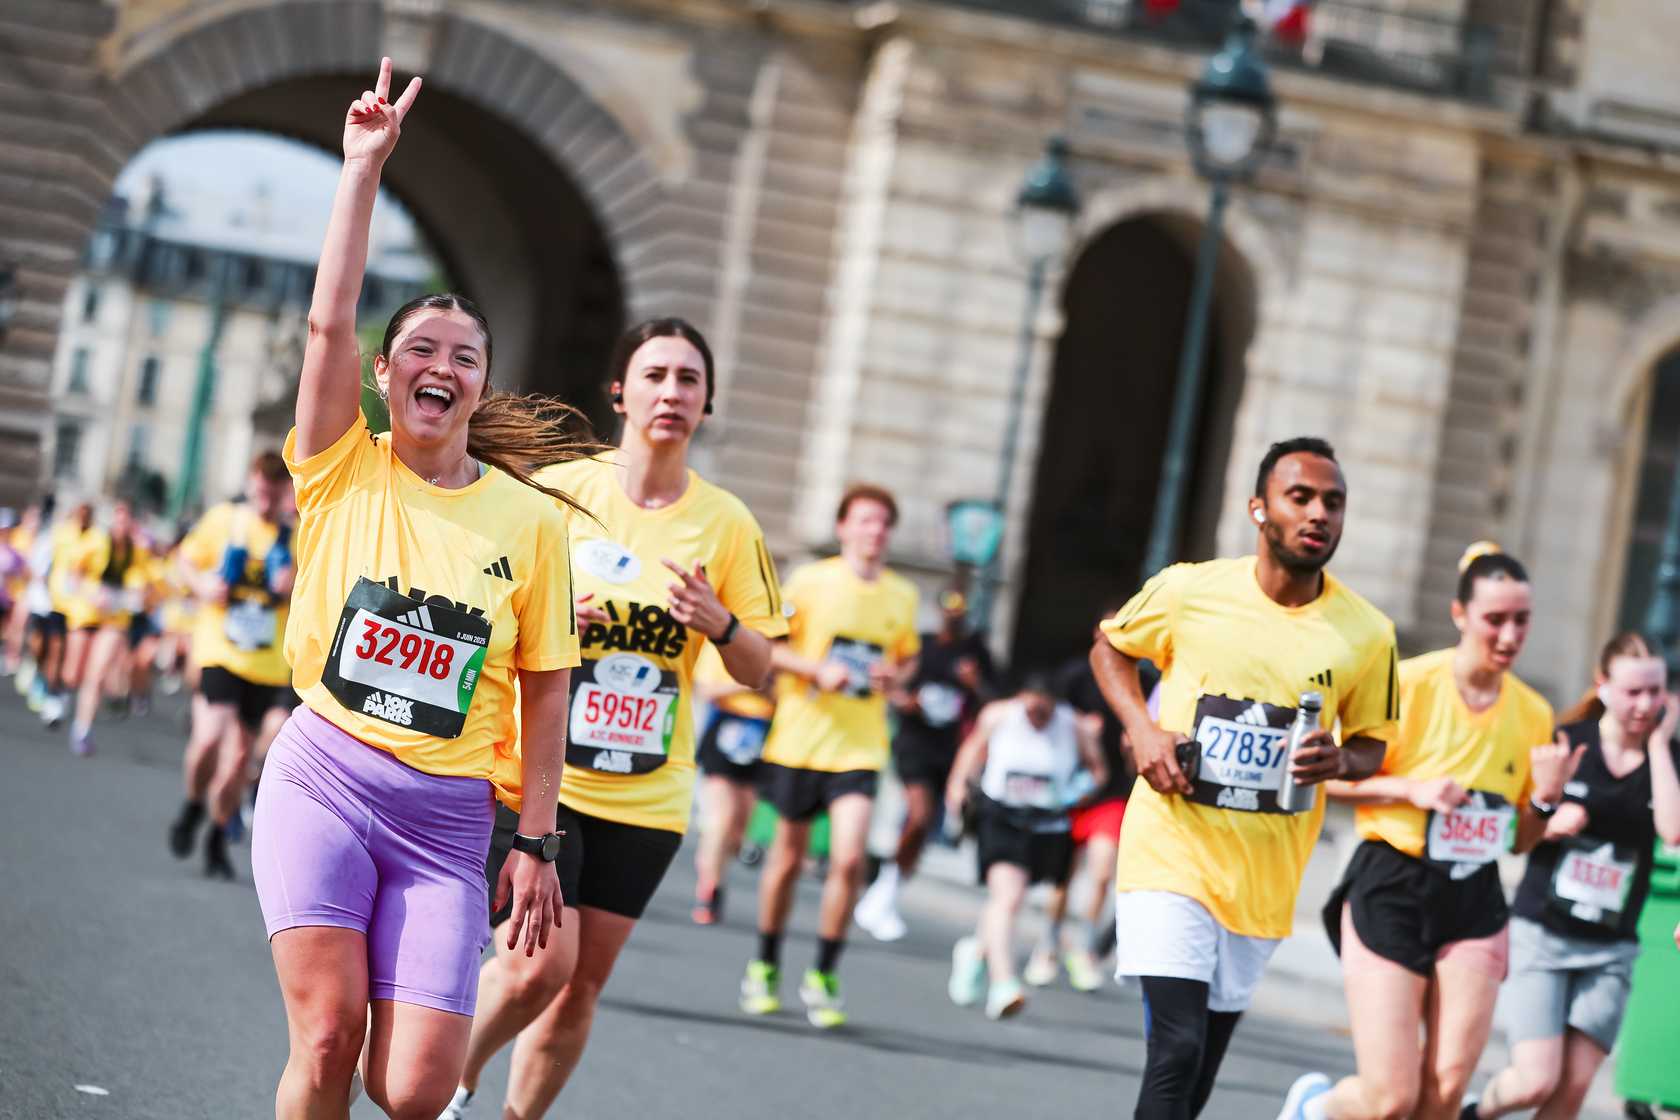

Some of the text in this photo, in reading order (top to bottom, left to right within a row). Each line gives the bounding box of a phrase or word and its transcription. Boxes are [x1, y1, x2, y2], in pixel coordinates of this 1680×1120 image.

[355, 619, 455, 681] 32918
[456, 631, 486, 645] 8 JUIN 2025
[581, 622, 686, 659] PARIS
[462, 668, 477, 691] 54 MIN
[362, 698, 413, 726] PARIS
[384, 693, 415, 719] 10K
[584, 690, 659, 732] 59512
[1205, 725, 1286, 769] 27837
